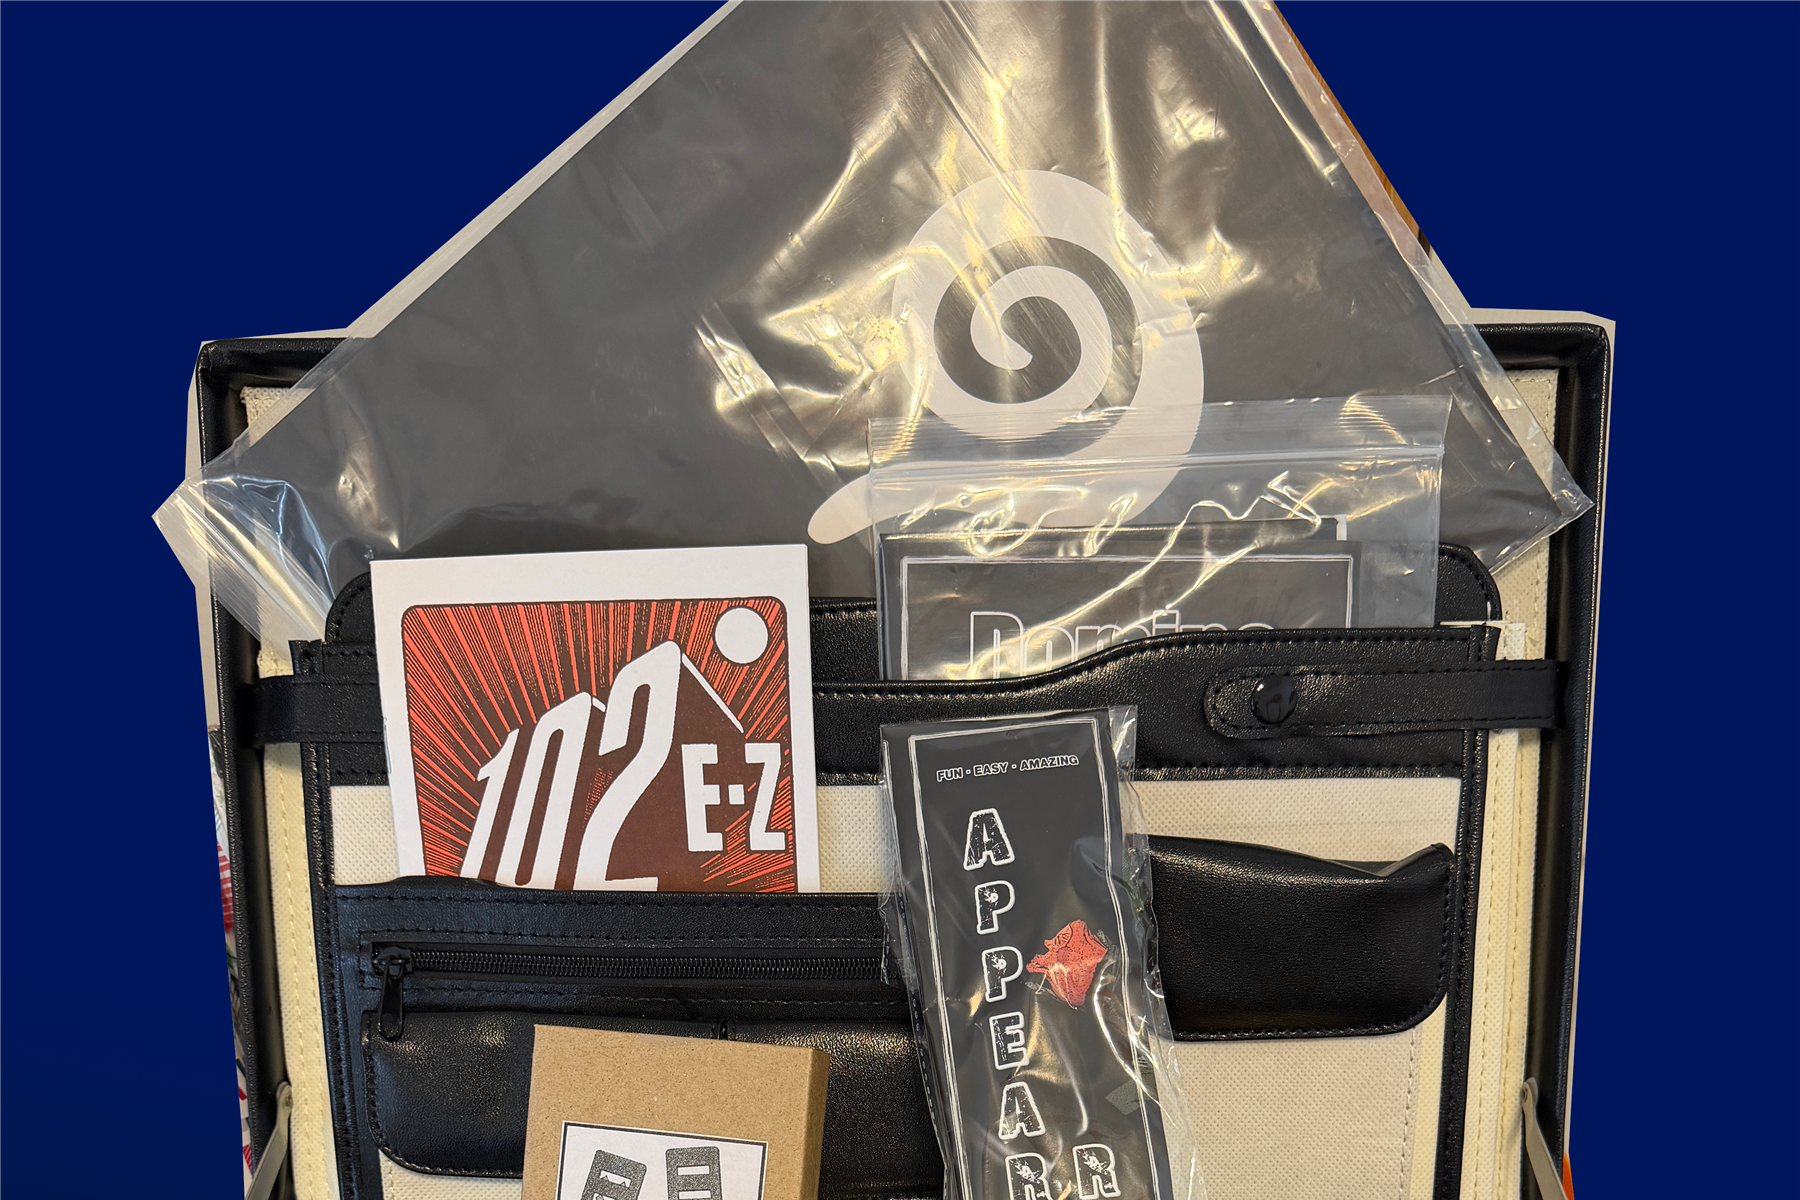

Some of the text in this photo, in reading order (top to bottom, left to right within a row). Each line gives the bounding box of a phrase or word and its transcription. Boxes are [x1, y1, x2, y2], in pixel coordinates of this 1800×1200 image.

[461, 640, 786, 891] 102 E-Z
[936, 755, 1080, 783] FUN EASY AMAZING
